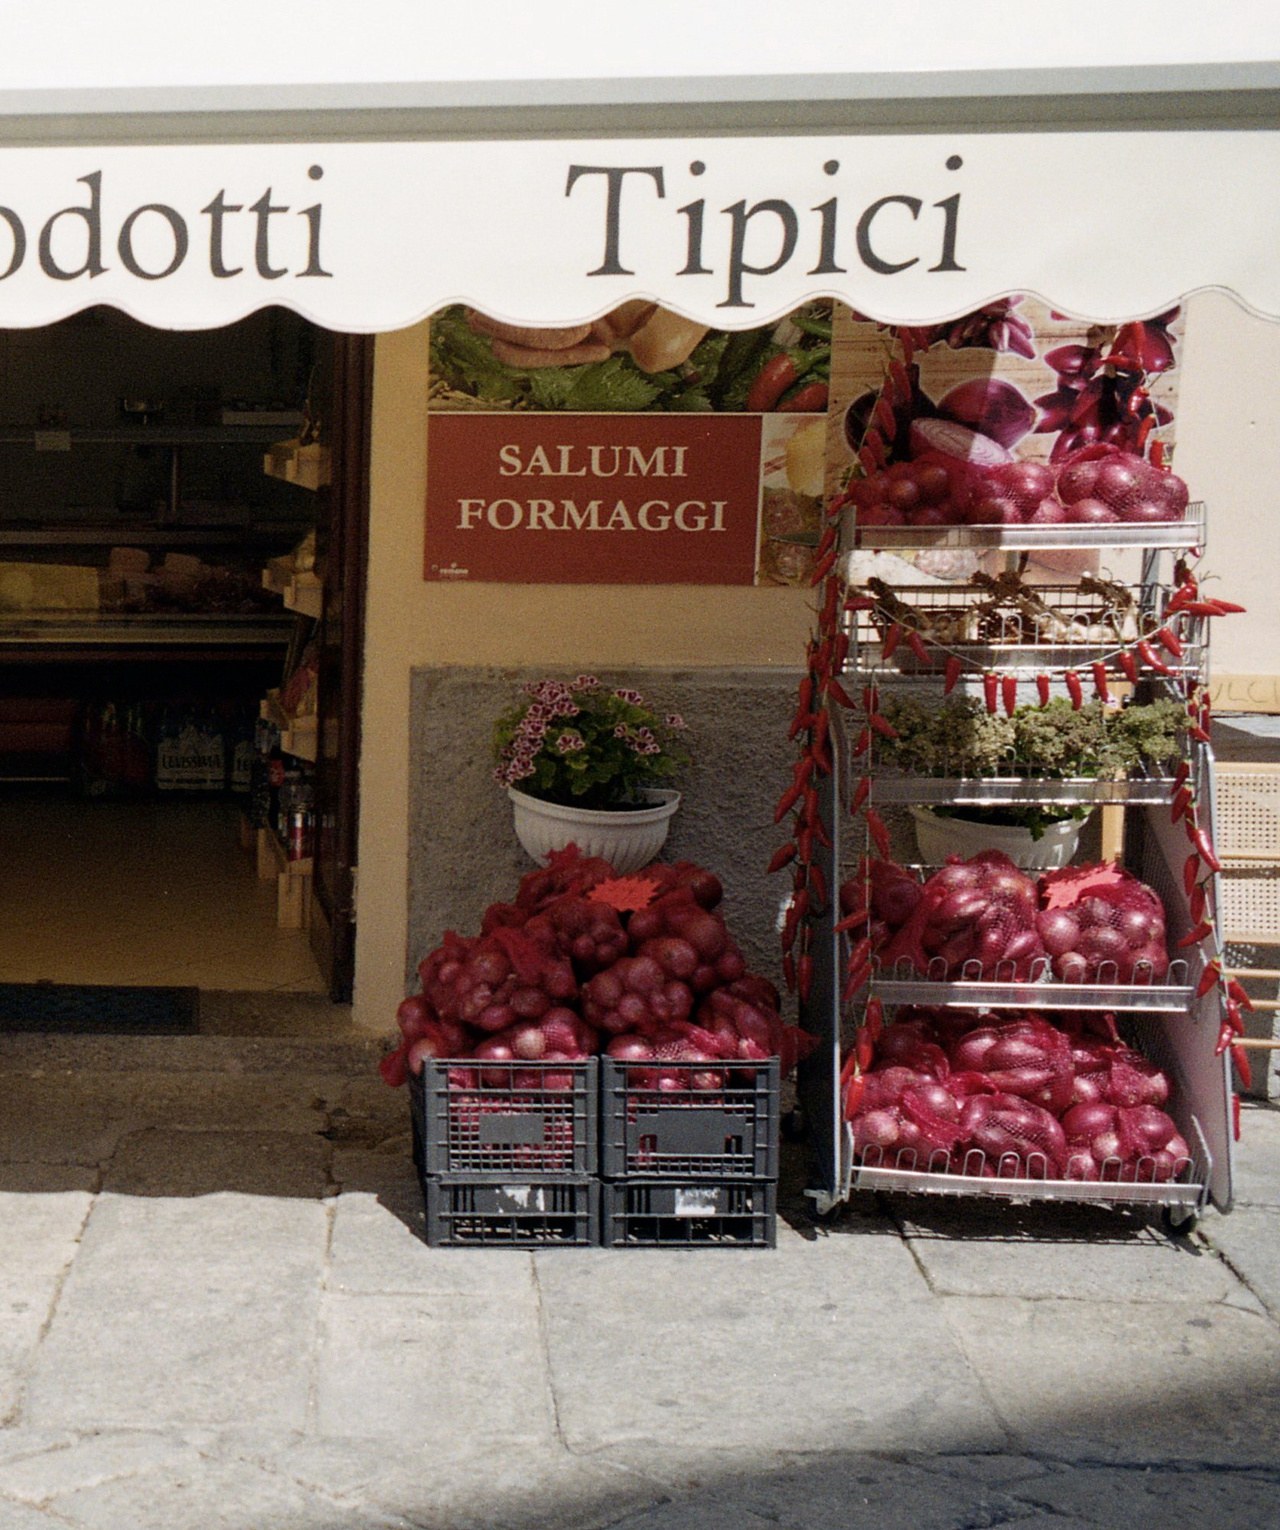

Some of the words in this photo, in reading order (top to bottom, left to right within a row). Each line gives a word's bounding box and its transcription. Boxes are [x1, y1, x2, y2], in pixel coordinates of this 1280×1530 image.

[566, 156, 966, 307] Tipici
[500, 445, 688, 477] SALUMI
[457, 499, 727, 532] FORMAGGI
